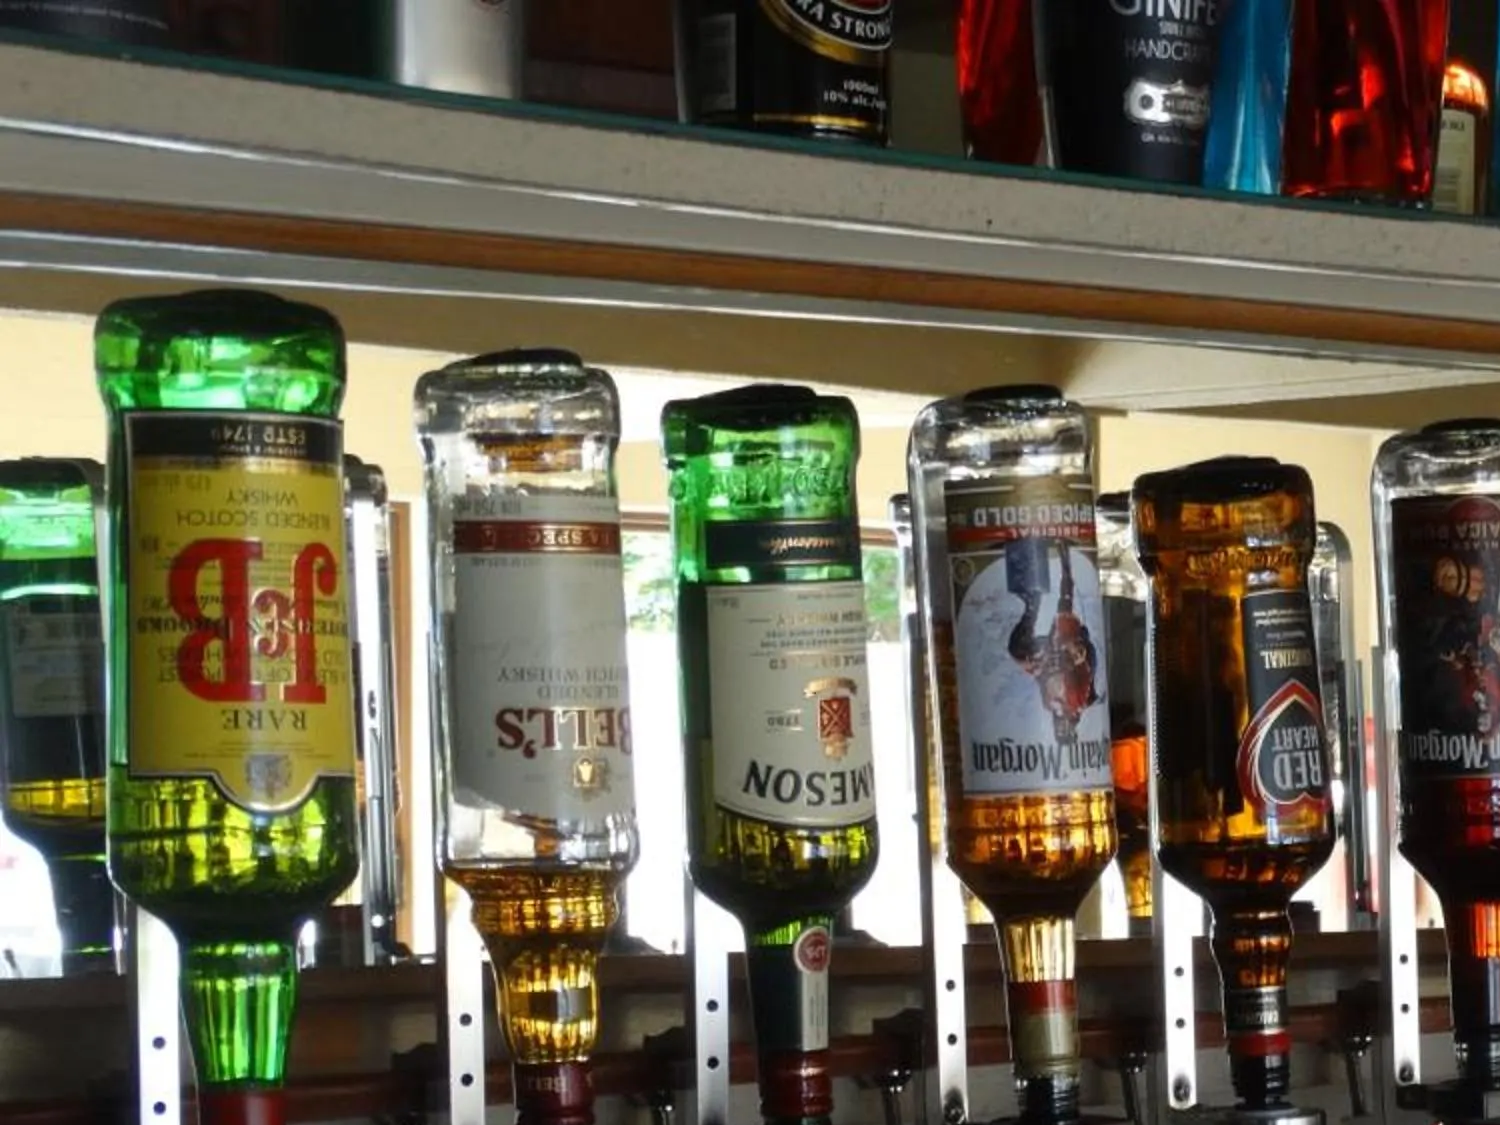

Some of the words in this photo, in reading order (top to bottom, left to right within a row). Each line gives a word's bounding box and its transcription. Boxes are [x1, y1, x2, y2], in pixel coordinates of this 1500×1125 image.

[225, 488, 299, 507] WHISKY
[176, 508, 257, 528] SCOTCH
[972, 504, 1031, 528] GOLD
[220, 708, 307, 733] RARE
[495, 707, 632, 760] BELL'S
[1272, 725, 1319, 750] HEART
[970, 736, 1066, 780] Morgan
[1406, 729, 1490, 769] Morgan
[1272, 750, 1323, 792] RED
